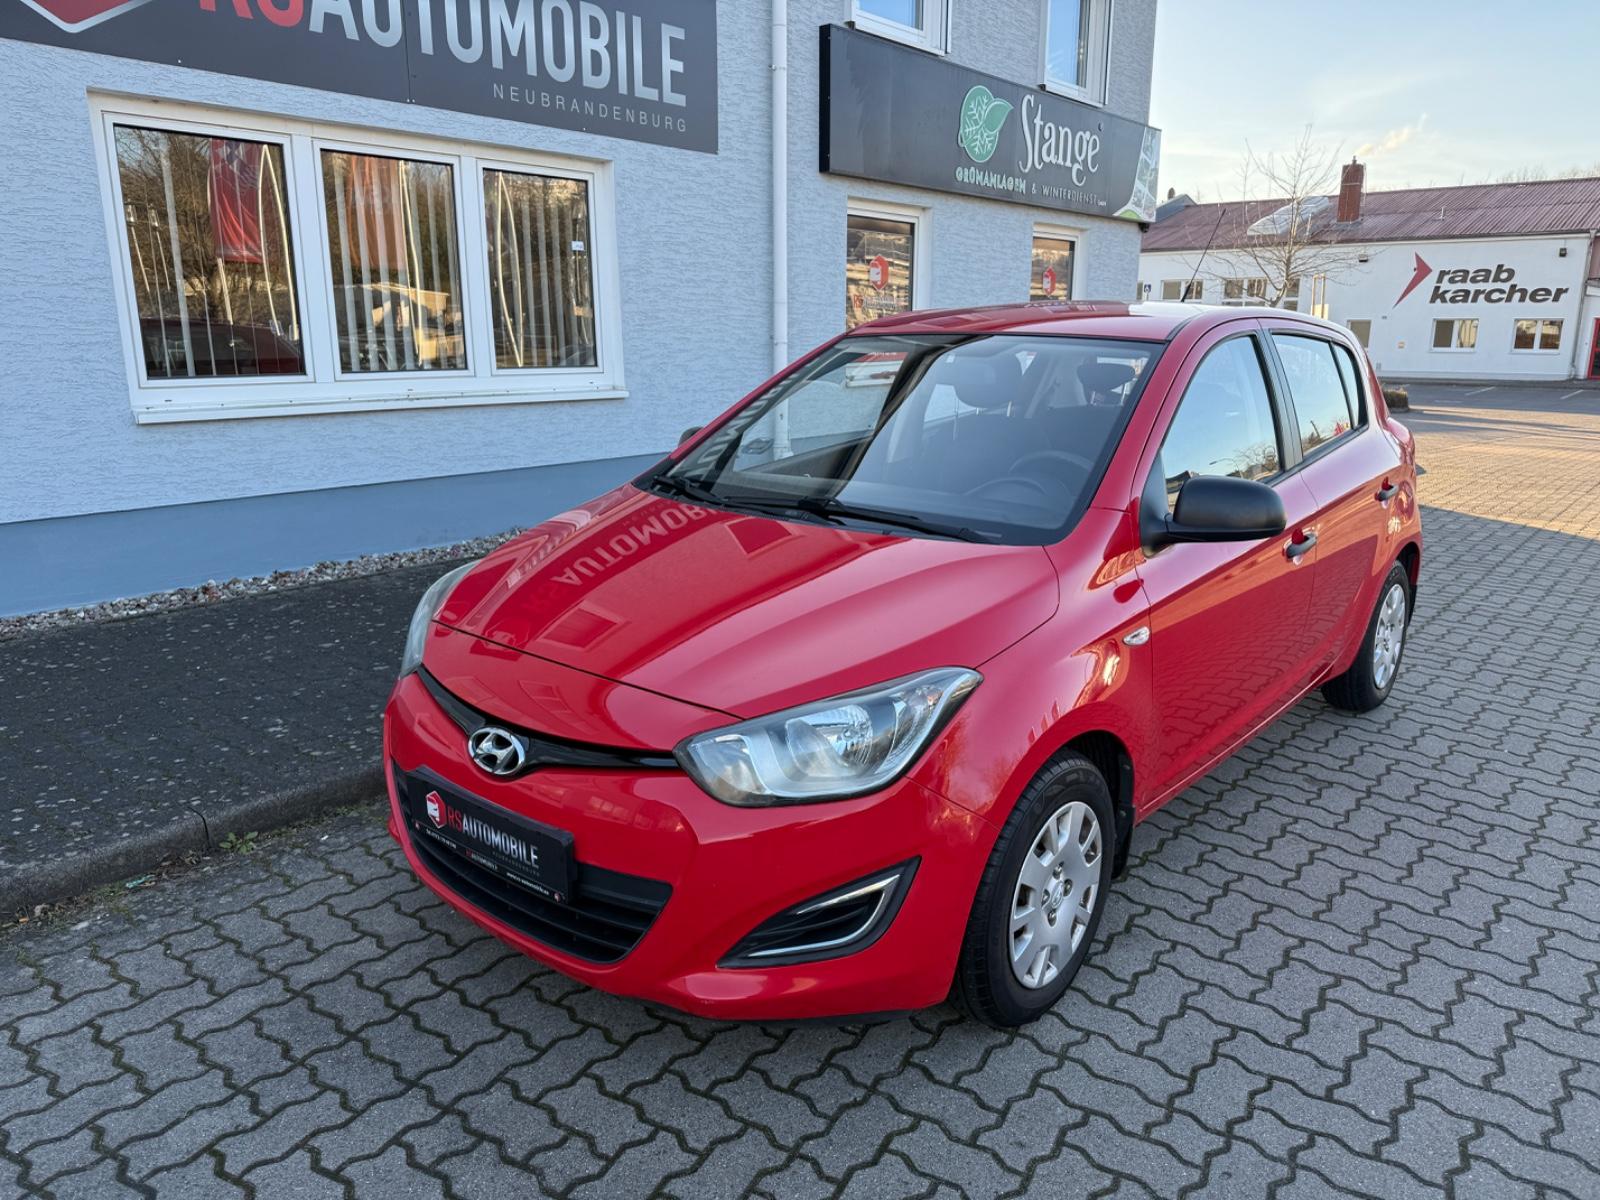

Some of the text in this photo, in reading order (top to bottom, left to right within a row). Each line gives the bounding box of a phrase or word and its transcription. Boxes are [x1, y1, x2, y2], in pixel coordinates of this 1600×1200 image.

[493, 83, 687, 133] NEUBRANDENBURG
[1019, 94, 1101, 186] Stange
[1031, 183, 1037, 194] &
[1436, 264, 1515, 284] raab
[1429, 284, 1569, 304] karcher
